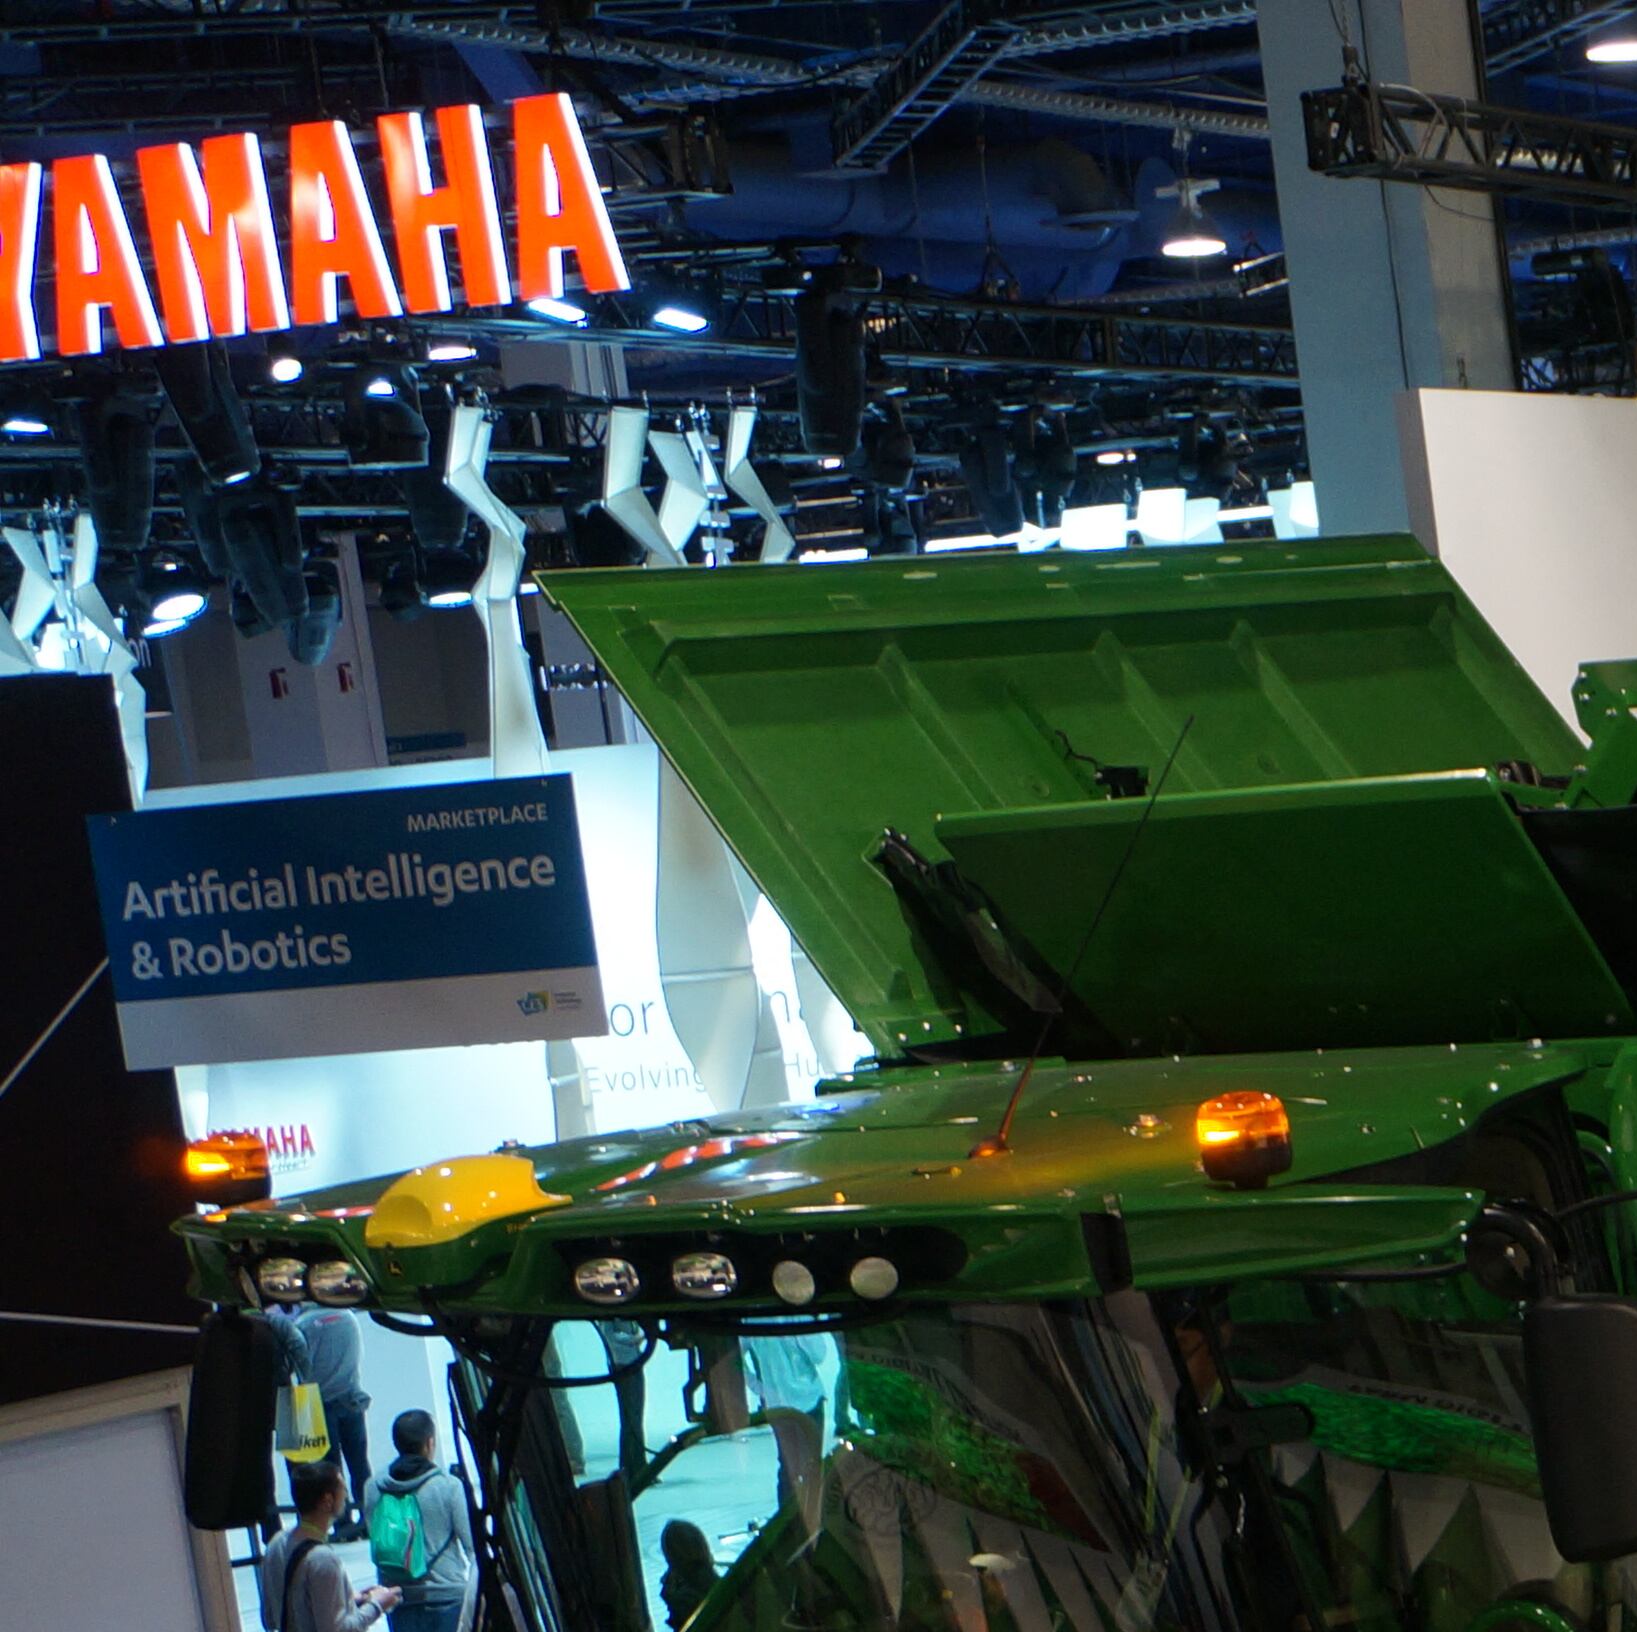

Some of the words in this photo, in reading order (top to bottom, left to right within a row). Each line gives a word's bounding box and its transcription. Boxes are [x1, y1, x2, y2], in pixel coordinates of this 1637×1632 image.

[406, 802, 549, 833] MARKETPLACE
[123, 863, 298, 922] Artificial
[306, 854, 556, 908] Intelligence
[131, 940, 162, 981] &
[169, 925, 352, 977] Robotics
[585, 1061, 707, 1094] Evolving
